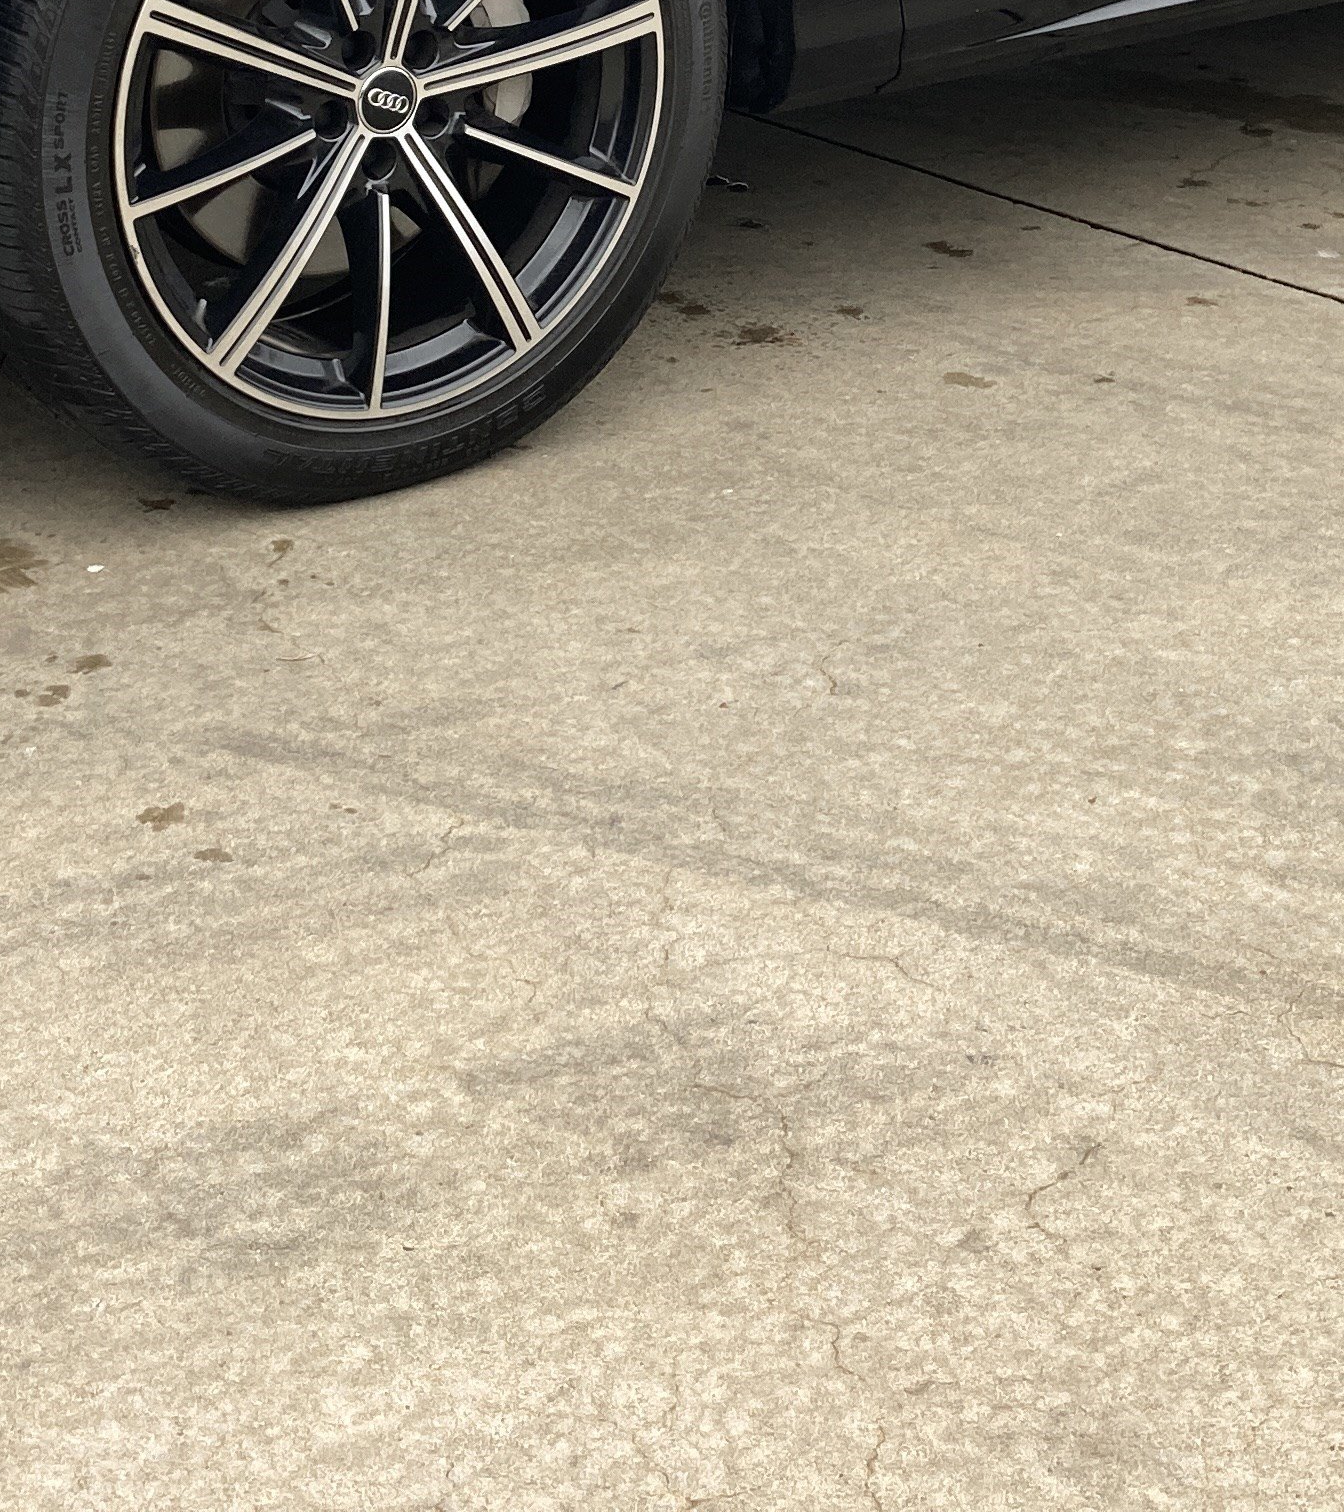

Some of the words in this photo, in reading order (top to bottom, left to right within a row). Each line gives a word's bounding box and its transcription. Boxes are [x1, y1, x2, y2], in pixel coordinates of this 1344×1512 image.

[53, 91, 69, 150] SPORT
[55, 199, 75, 257] CROSS
[67, 197, 83, 254] CONTACT
